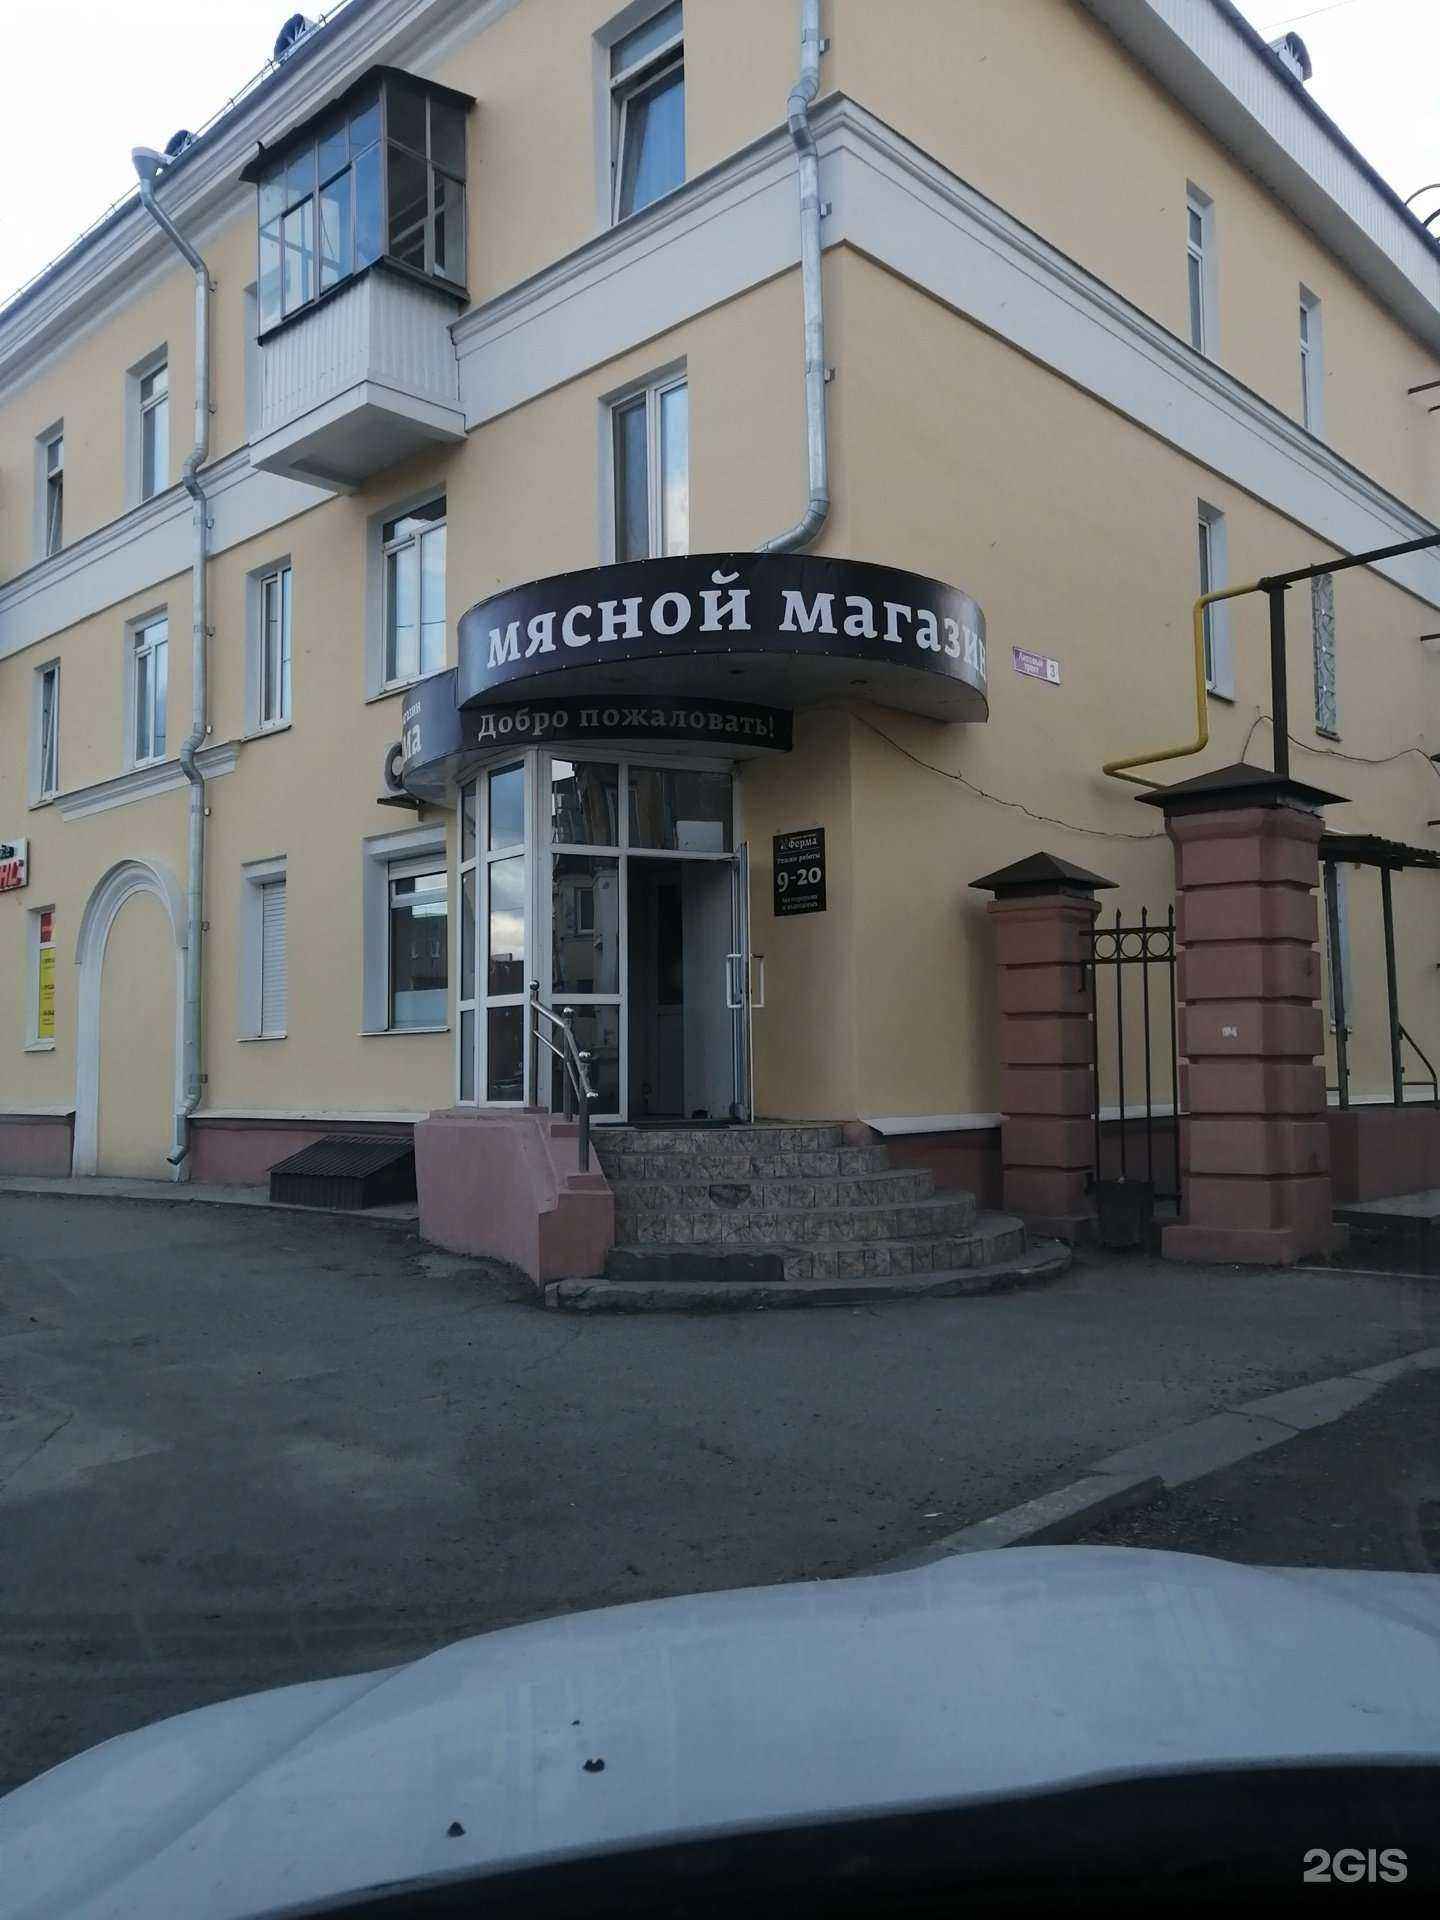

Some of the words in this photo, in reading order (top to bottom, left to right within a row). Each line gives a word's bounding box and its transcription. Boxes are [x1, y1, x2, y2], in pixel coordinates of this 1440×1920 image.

[487, 569, 751, 669] мясной
[1049, 664, 1056, 678] 3
[478, 707, 569, 742] Добро
[579, 705, 775, 738] пожаловать!
[788, 838, 818, 849] Ферма
[776, 866, 822, 893] 9-20
